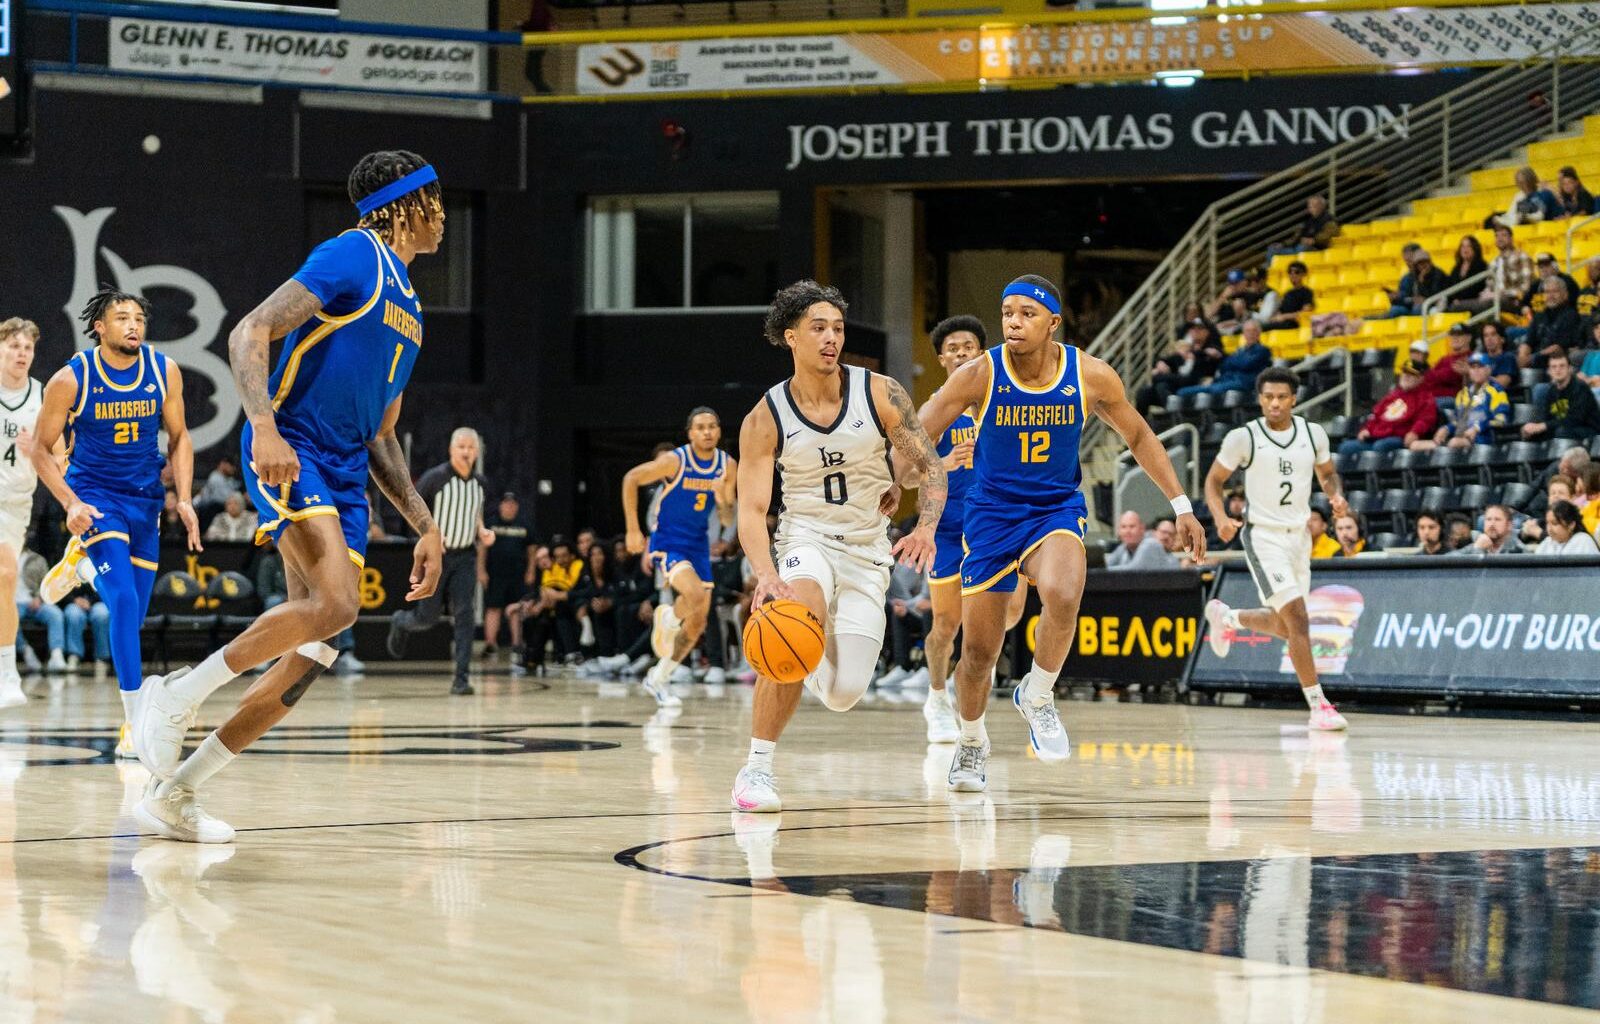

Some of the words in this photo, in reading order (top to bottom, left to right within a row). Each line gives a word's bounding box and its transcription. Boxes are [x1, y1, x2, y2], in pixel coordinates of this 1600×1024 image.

[121, 23, 208, 49] GLENN
[215, 30, 233, 51] E.
[245, 33, 349, 59] THOMAS
[939, 29, 1199, 53] COMMISSIONER'S
[1217, 27, 1274, 41] CUP
[1331, 17, 1388, 57] 2005-06
[1392, 14, 1449, 55] 2010-11
[1424, 13, 1479, 52] 2011-12
[1454, 13, 1511, 51] 2012-13
[1487, 12, 1542, 50] 2013-14
[367, 43, 474, 62] #GOBEACH
[651, 59, 677, 72] BIG
[985, 43, 1235, 67] CHAMPIONSHIPS
[648, 73, 691, 87] WEST
[786, 121, 951, 169] JOSEPH
[966, 112, 1175, 155] THOMAS
[1191, 103, 1412, 148] GANNON
[383, 298, 422, 348] BAKERSFIELD
[388, 342, 404, 383] 1
[95, 399, 157, 419] BAKERSFIELD
[995, 404, 1075, 426] BAKERSFIELD
[114, 421, 139, 444] 21
[1018, 430, 1050, 463] 12
[4, 443, 16, 466] 4
[694, 493, 708, 512] 3
[823, 471, 848, 505] 0
[1279, 481, 1294, 506] 2
[1078, 615, 1197, 658] BEACH
[1373, 613, 1524, 650] IN-N-OUT
